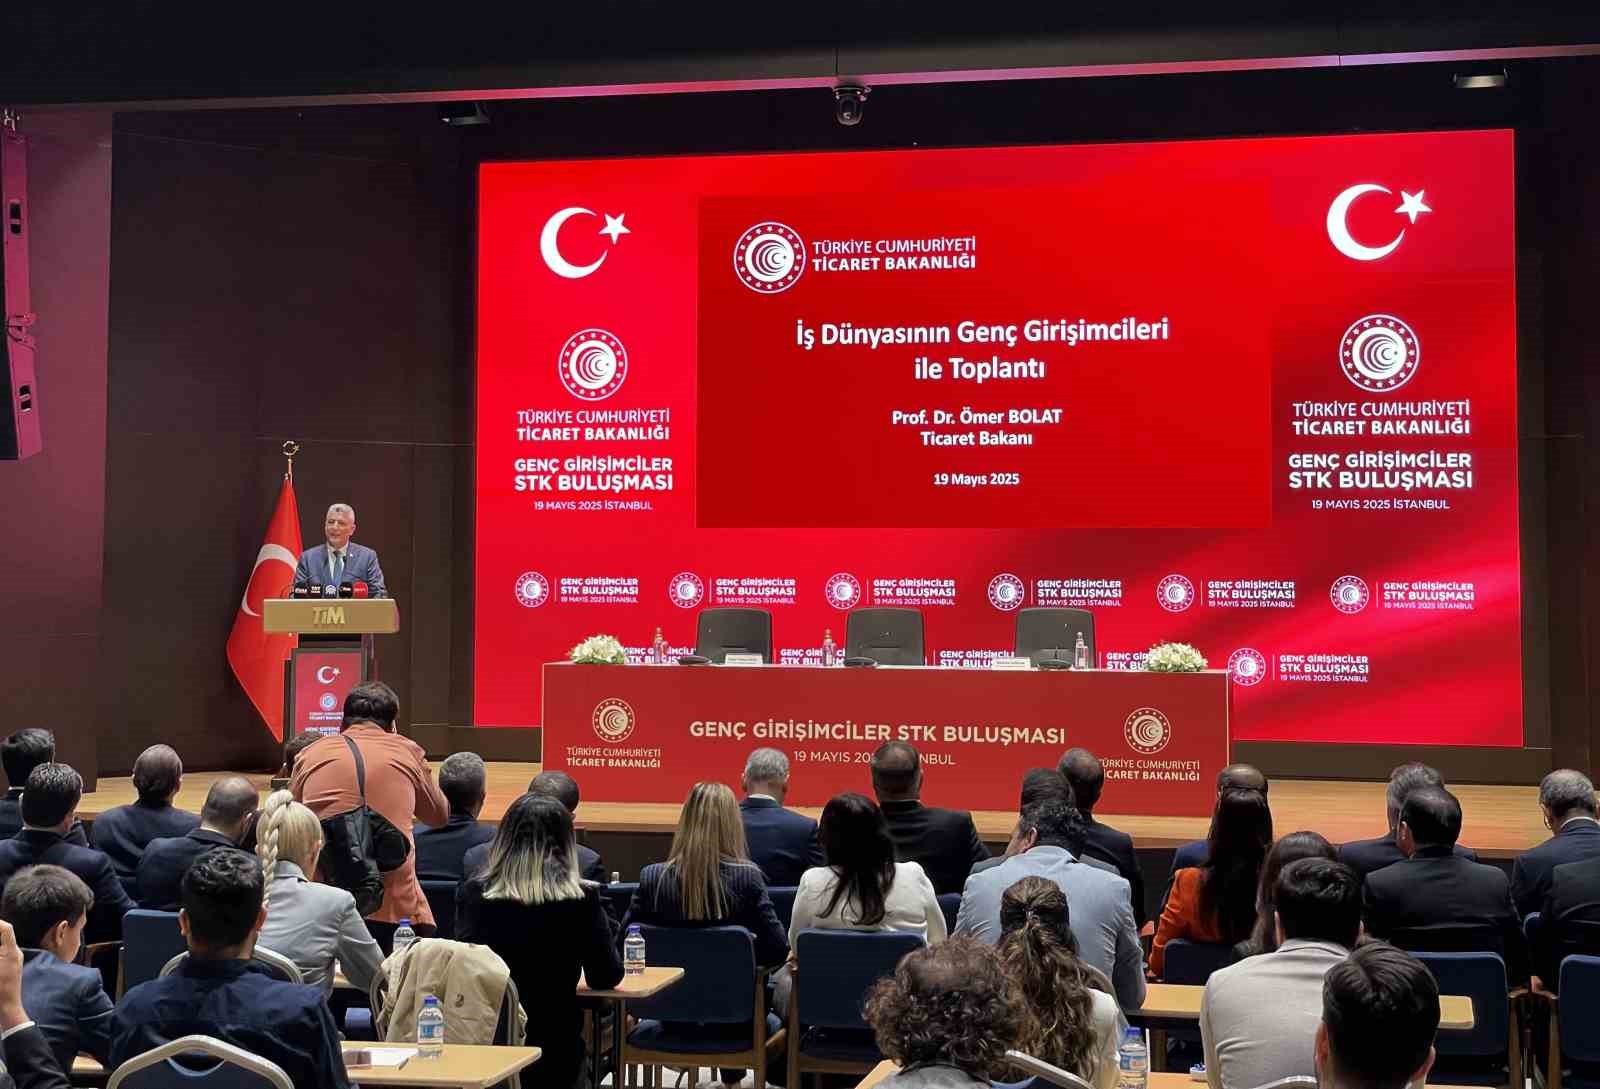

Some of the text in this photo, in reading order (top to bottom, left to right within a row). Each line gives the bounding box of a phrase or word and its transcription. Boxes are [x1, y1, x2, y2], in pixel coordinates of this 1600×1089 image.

[812, 236, 977, 254] TÜRKİYE CUMHURİYETİ
[812, 253, 977, 272] TİCARET BAKANLIĞI
[796, 317, 1170, 350] İş Dünyasının Genç Girişimcileri
[914, 356, 1046, 384] ile Toplantı
[892, 406, 1063, 425] Prof. Dr. Ömer BOLAT
[1292, 399, 1471, 417] TÜRKİYE CUMHURİYETİ
[516, 407, 671, 425] TÜRKİYE CUMHURİYETİ
[516, 424, 671, 441] TİCARET BAKANLIĞI
[1292, 417, 1472, 435] TİCARET BAKANLIĞI
[920, 431, 1034, 446] Ticaret Bakanı
[513, 456, 673, 474] GENÇ GİRİŞİMCİLER
[1287, 449, 1473, 470] GENÇ GİRİŞİMCİLER
[513, 474, 674, 493] STK BULUŞMASI
[933, 473, 1020, 488] 19 Mayıs 2025
[1287, 472, 1474, 490] STK BULUŞMASI
[533, 498, 653, 510] 19 MAYIS 2025 İSTANBUL
[1311, 497, 1450, 510] 19 MAYIS 2025 İSTANBUL
[583, 587, 639, 597] BULUŞMASI
[738, 588, 796, 598] BULUŞMASI
[873, 588, 956, 598] STK BULUŞMASI
[1037, 588, 1122, 599] STK BULUŞMASI
[1208, 590, 1296, 600] STK BULUŞMASI
[1383, 592, 1475, 602] STK BULUŞMASI
[1280, 664, 1369, 674] STK BULUŞMASI
[689, 718, 1066, 746] GENÇ GİRİŞİMCİLER STK BULUŞMASI
[566, 747, 661, 758] TÜRKİYE CUMHURİYETİ
[793, 750, 956, 765] 19 MAYIS 20 NBUL
[566, 757, 661, 769] TİCARET BAKANLIĞI
[1137, 759, 1200, 770] CUMHURİYETİ
[1103, 769, 1200, 782] İCARET BAKANLIĞI
